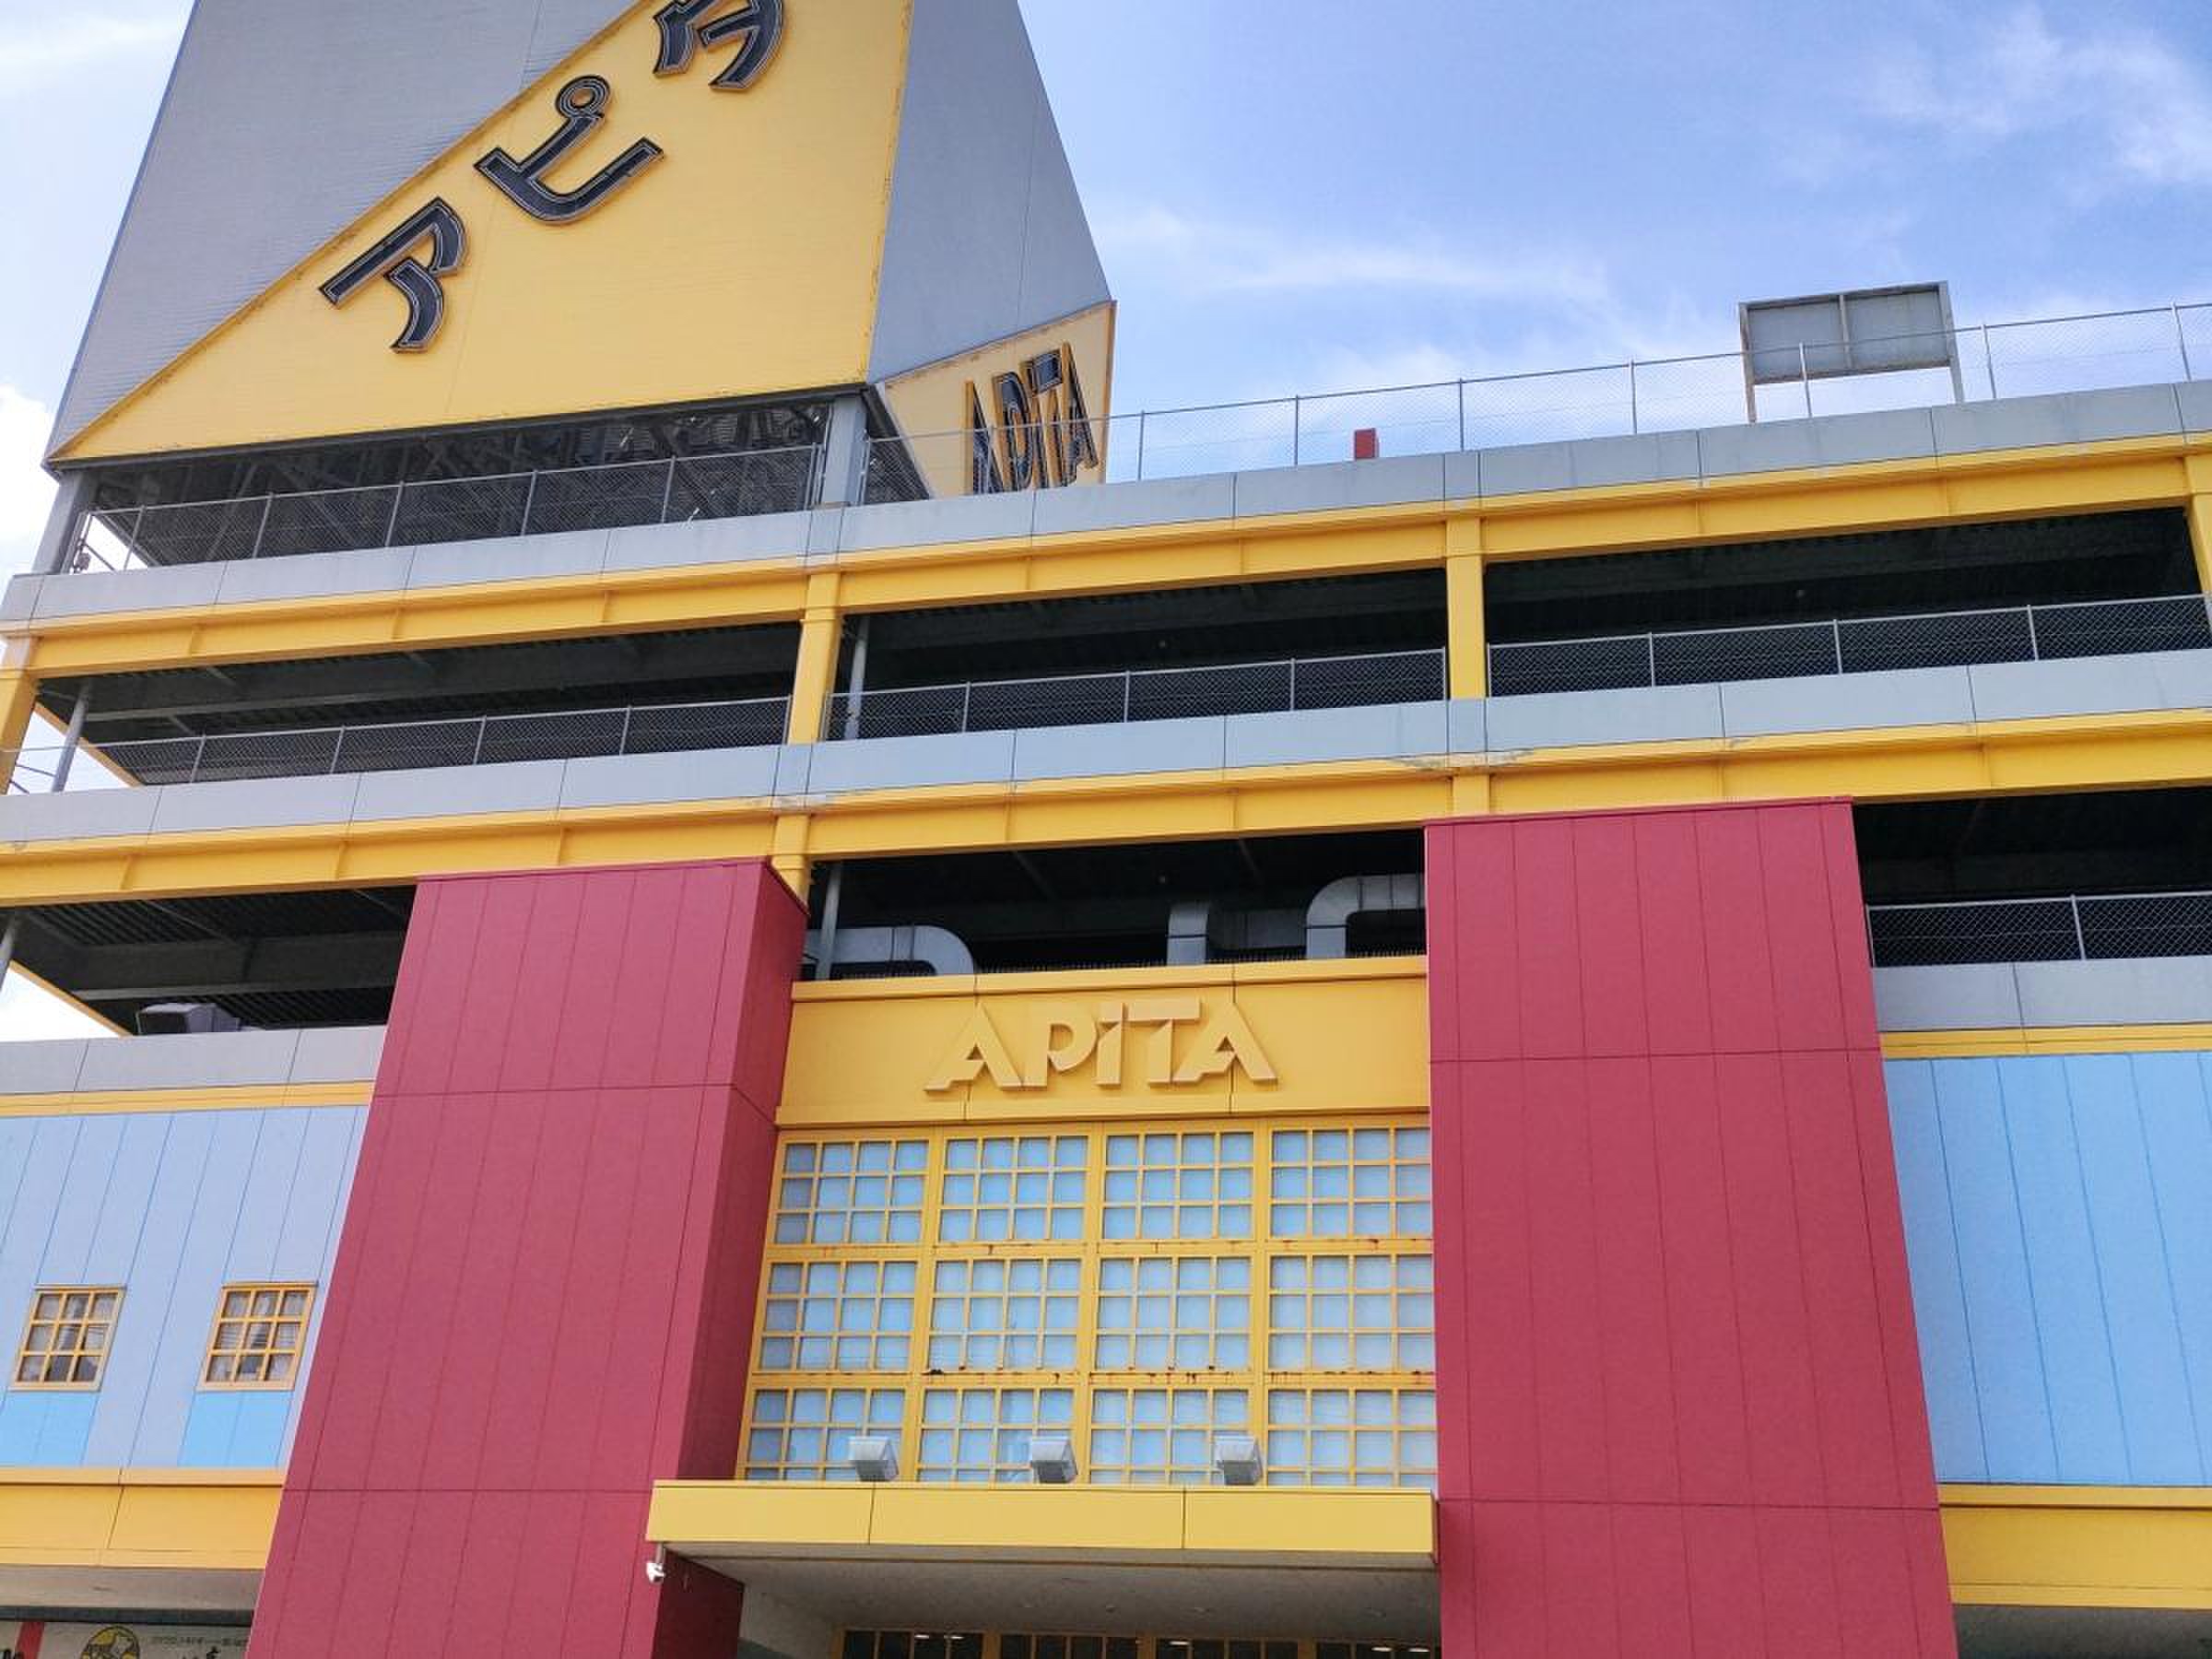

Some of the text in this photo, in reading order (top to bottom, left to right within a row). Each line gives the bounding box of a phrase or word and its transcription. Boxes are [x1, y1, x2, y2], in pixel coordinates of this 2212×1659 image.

[319, 0, 784, 354] アピタ
[924, 1001, 1277, 1092] APITA
